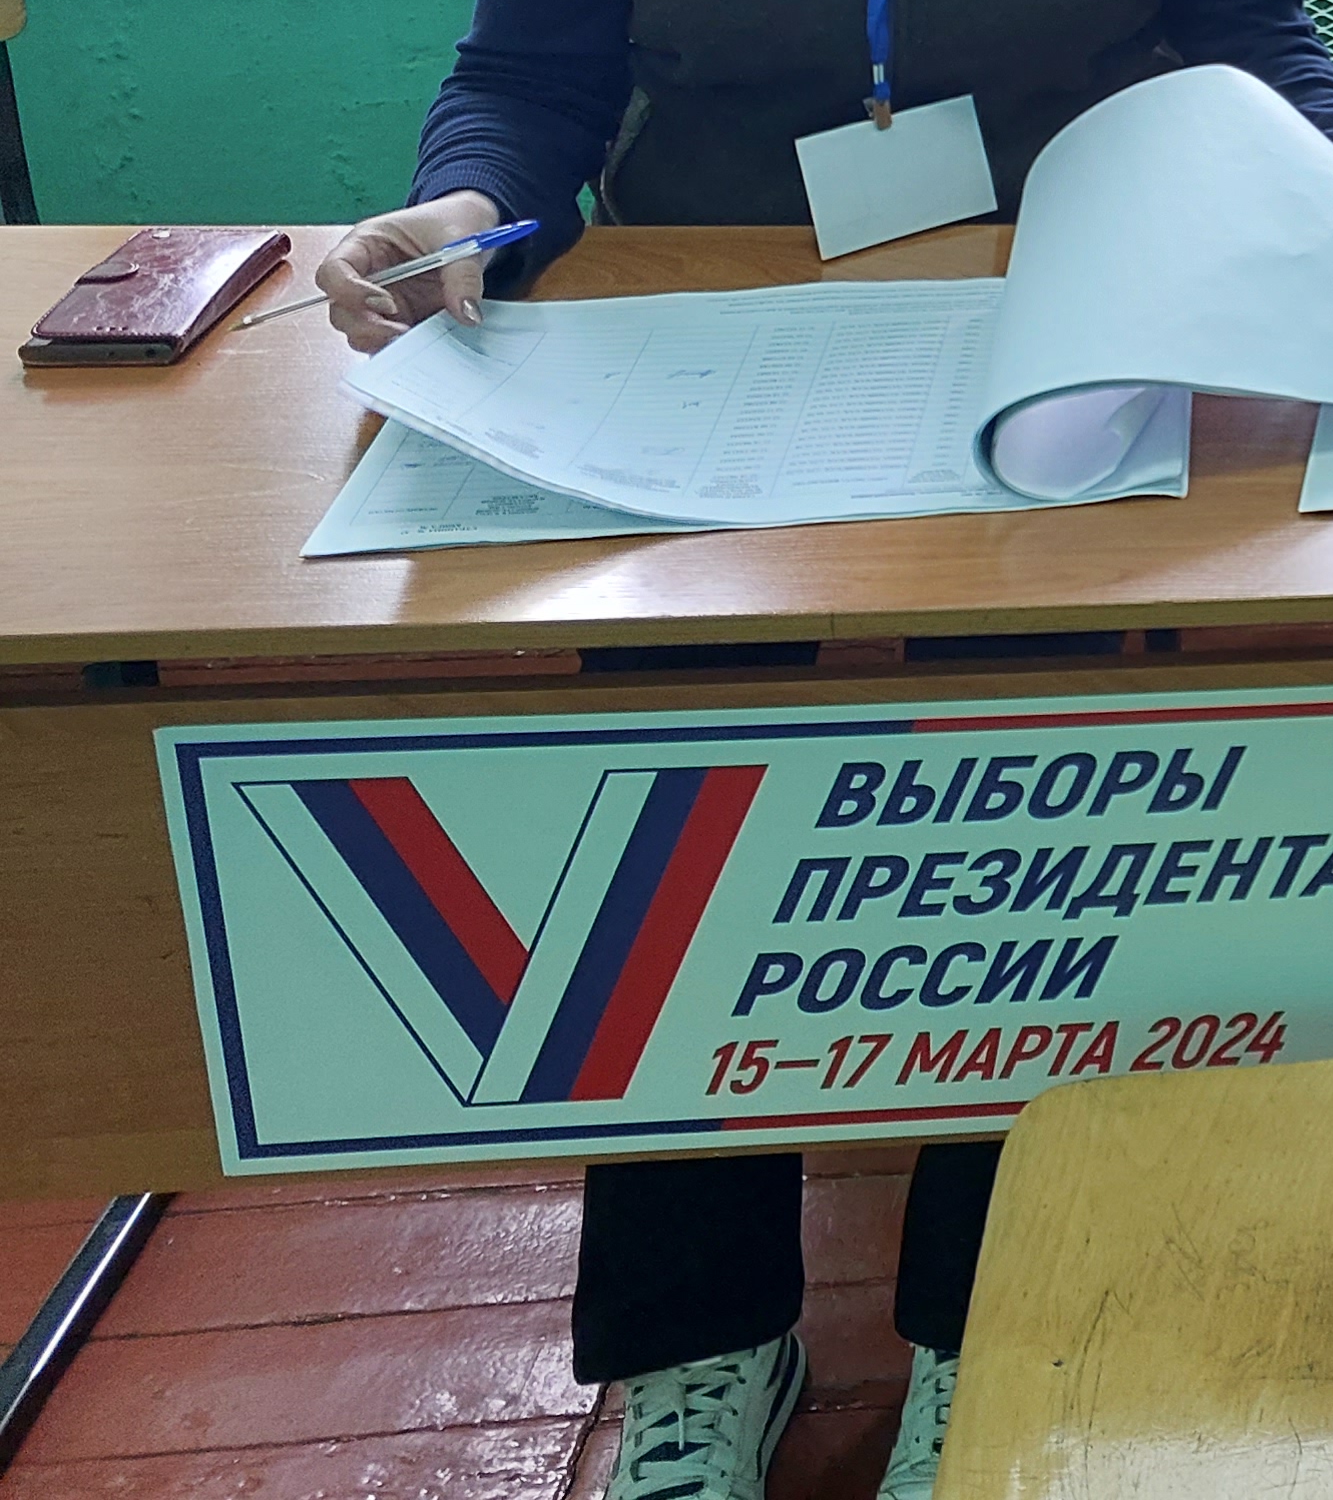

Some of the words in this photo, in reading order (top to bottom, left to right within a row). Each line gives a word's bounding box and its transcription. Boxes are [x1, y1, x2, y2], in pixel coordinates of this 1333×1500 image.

[813, 745, 1248, 829] ВЫБОРЫ
[730, 935, 1120, 1017] РОССИИ
[896, 1021, 1121, 1086] МАРТА
[1129, 1011, 1287, 1072] 2024
